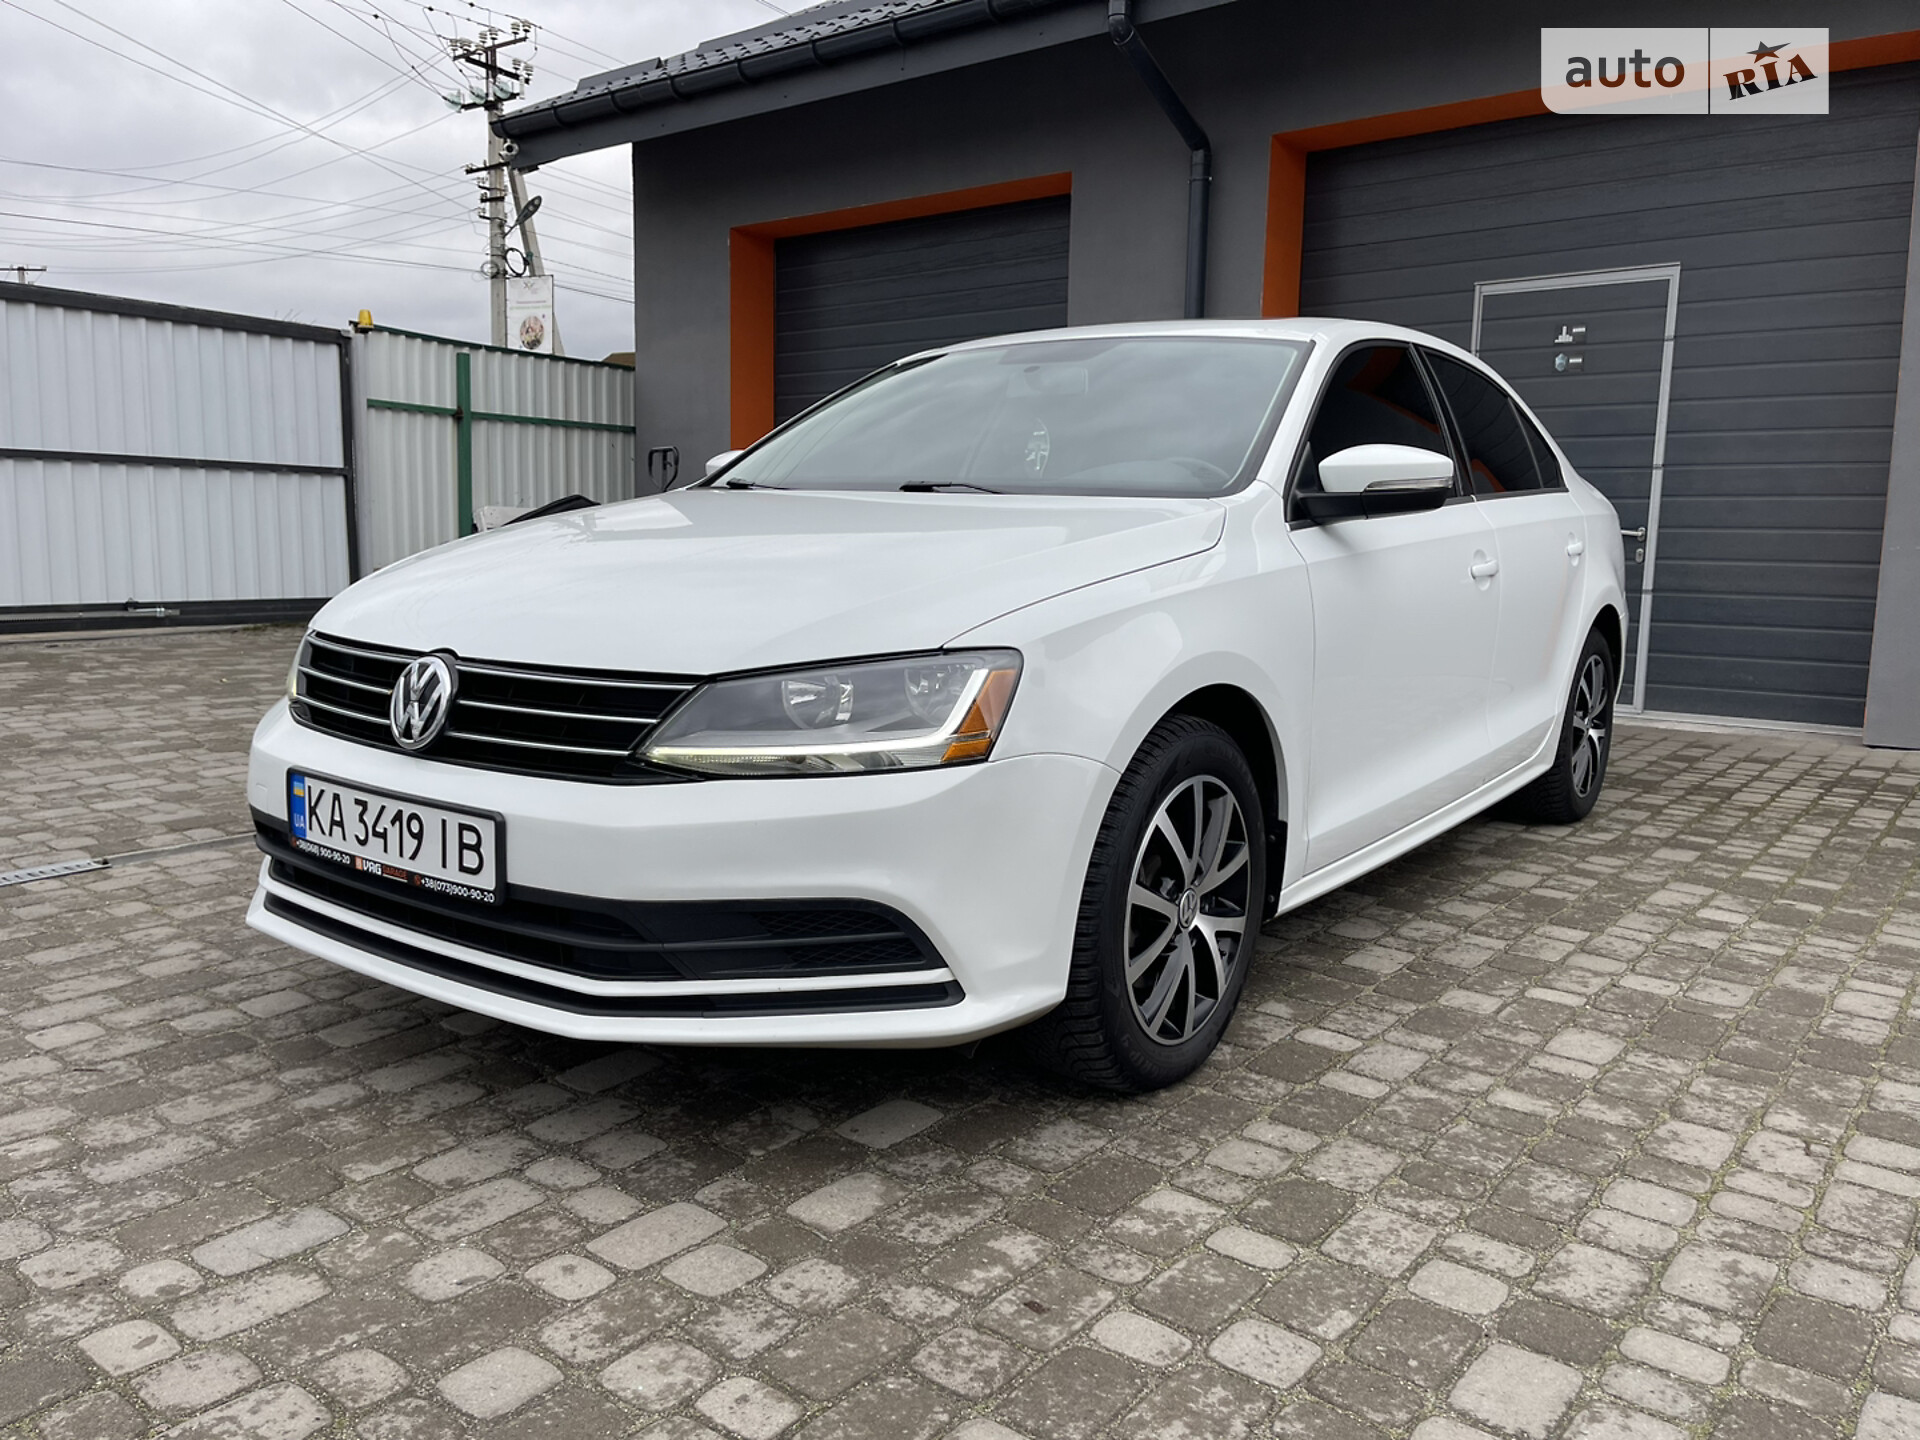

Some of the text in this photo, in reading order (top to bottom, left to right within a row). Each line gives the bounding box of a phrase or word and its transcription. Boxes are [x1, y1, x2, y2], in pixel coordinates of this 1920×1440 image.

[294, 813, 305, 828] UA
[307, 785, 484, 876] KA 3419 IB
[362, 859, 382, 876] VAG
